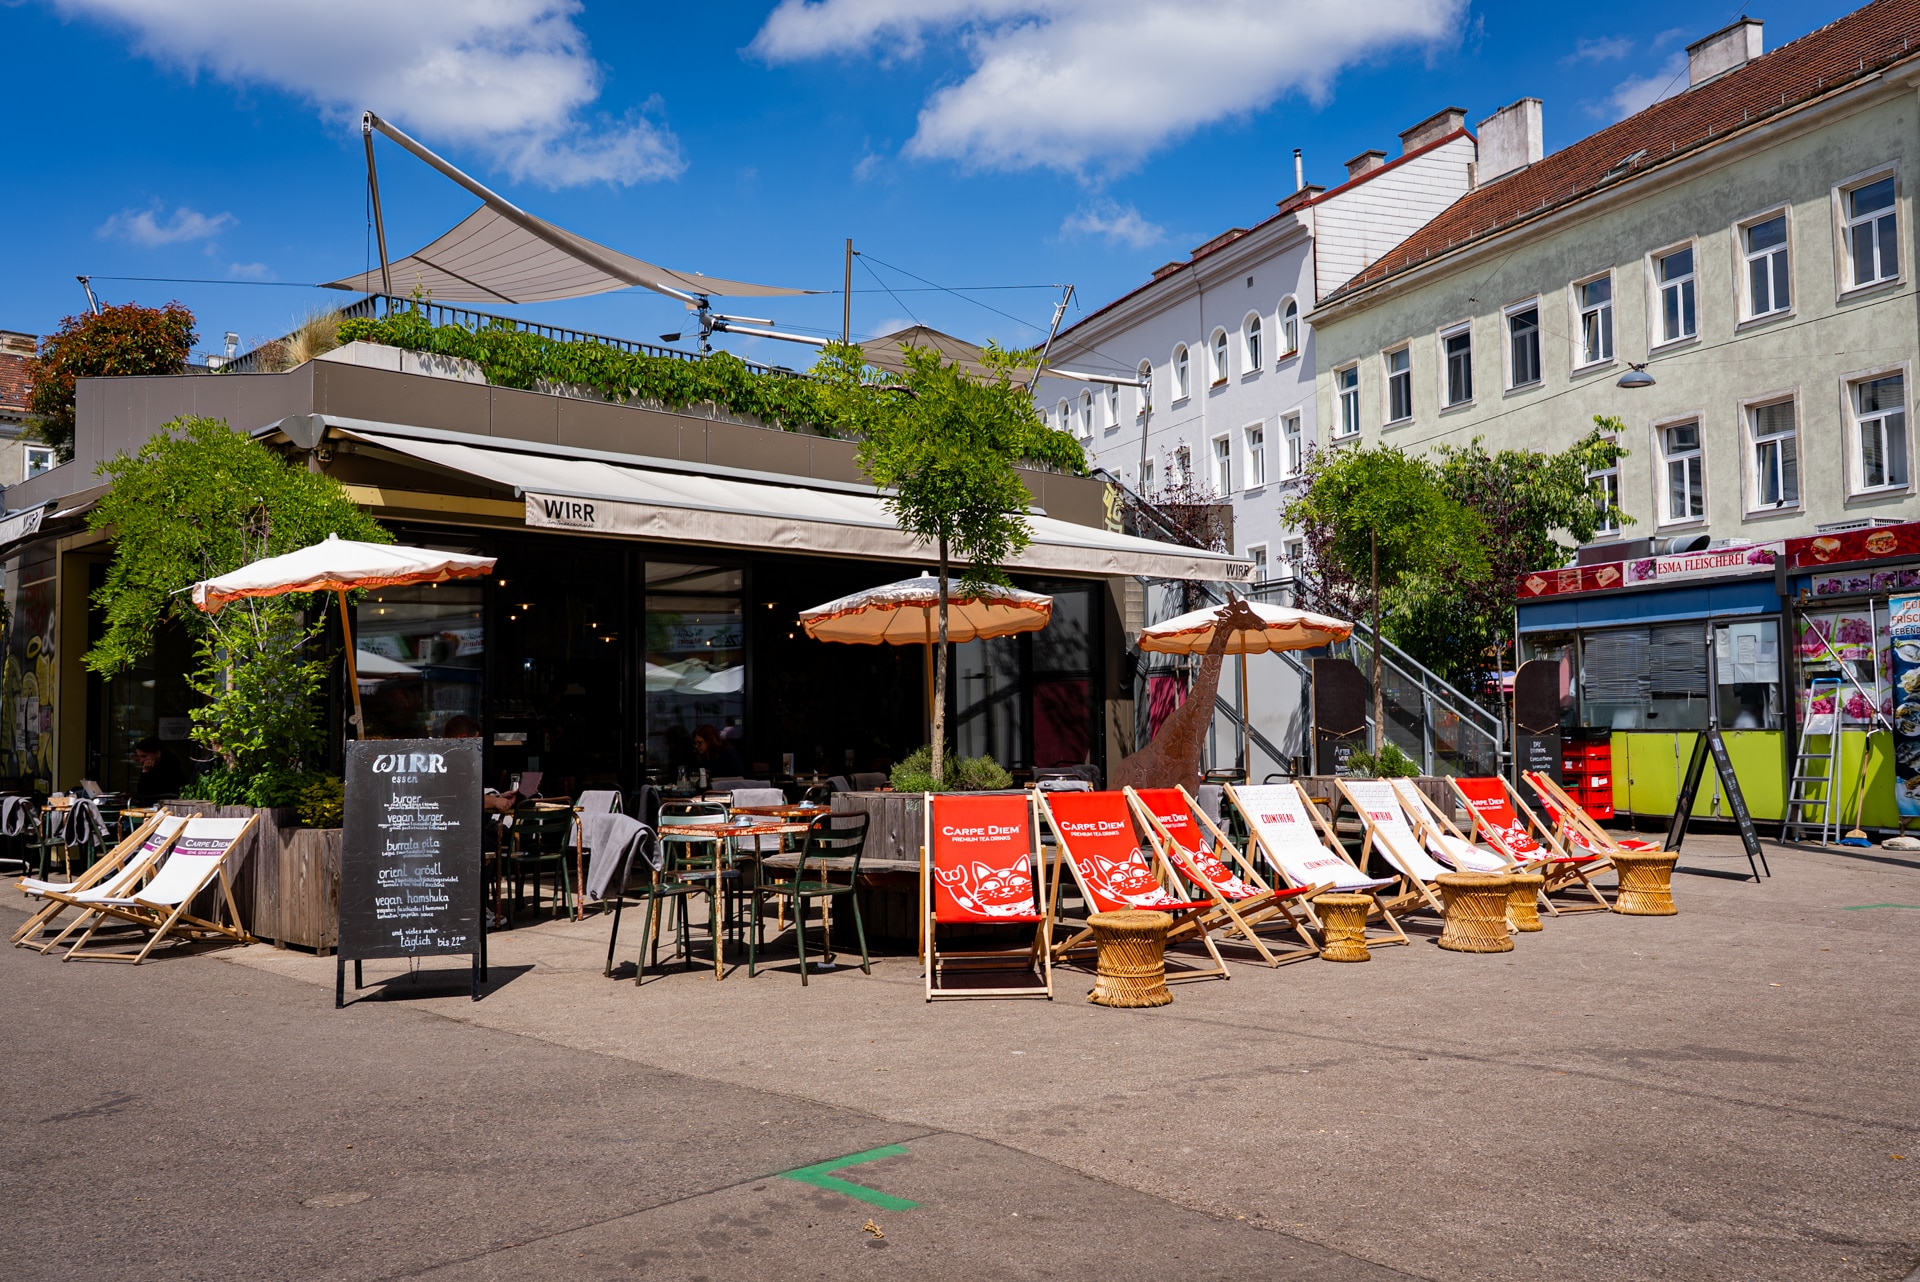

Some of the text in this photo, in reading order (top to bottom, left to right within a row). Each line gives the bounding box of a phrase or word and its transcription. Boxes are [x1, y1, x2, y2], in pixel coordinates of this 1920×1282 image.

[544, 499, 595, 522] WIRR
[1226, 563, 1250, 577] WIRR
[1657, 553, 1745, 574] ESMA FLEISCHEREI
[372, 753, 448, 774] WIRR
[391, 775, 418, 783] essen
[392, 792, 422, 805] burger
[1487, 797, 1505, 806] DIEM
[387, 809, 444, 824] vegan burger
[1157, 813, 1189, 823] ARPE DIEM
[1261, 813, 1296, 824] COINTREAU
[942, 825, 1020, 836] CARPE DIEM
[1060, 820, 1125, 831] CARPE DIEM
[185, 839, 211, 848] CARPE
[386, 836, 440, 852] burrata pita
[379, 863, 408, 879] orient
[1303, 859, 1344, 870] COINTREAU
[375, 889, 450, 909] vegan hamshuka
[392, 928, 403, 937] und
[405, 927, 422, 935] vieles
[400, 934, 432, 952] täglich
[437, 937, 449, 947] bis
